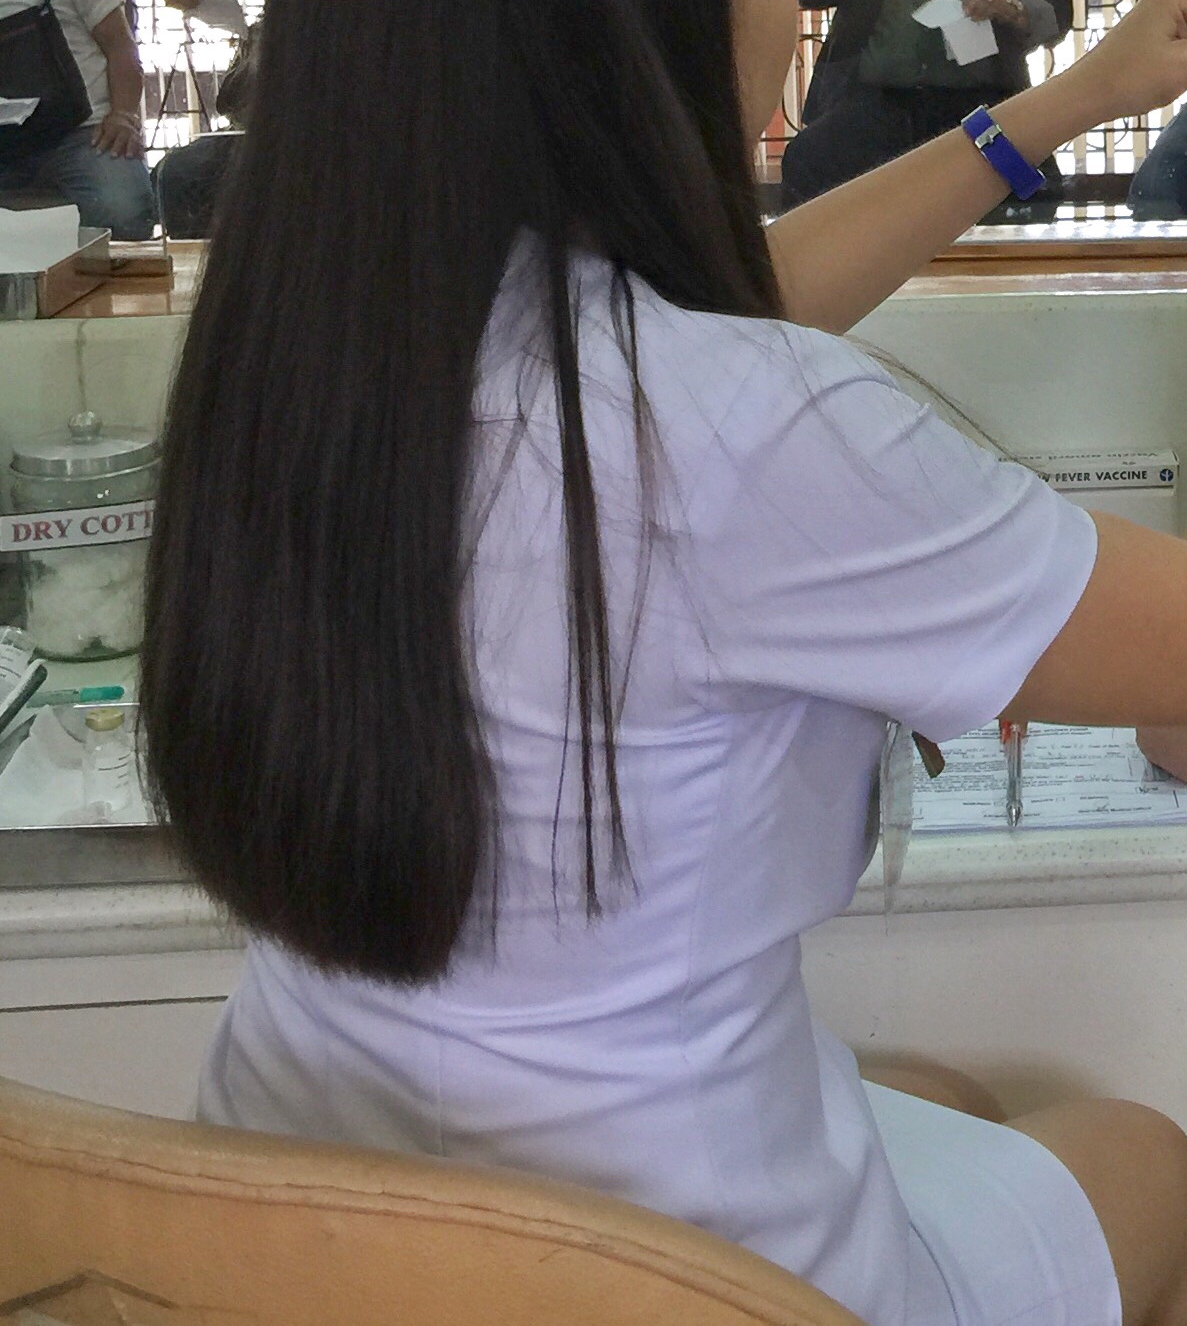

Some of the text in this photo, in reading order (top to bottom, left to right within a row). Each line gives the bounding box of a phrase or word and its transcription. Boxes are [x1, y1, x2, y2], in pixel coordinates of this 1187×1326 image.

[1055, 472, 1091, 483] FEVER
[1095, 470, 1148, 481] VACCINE
[11, 518, 73, 543] DRY
